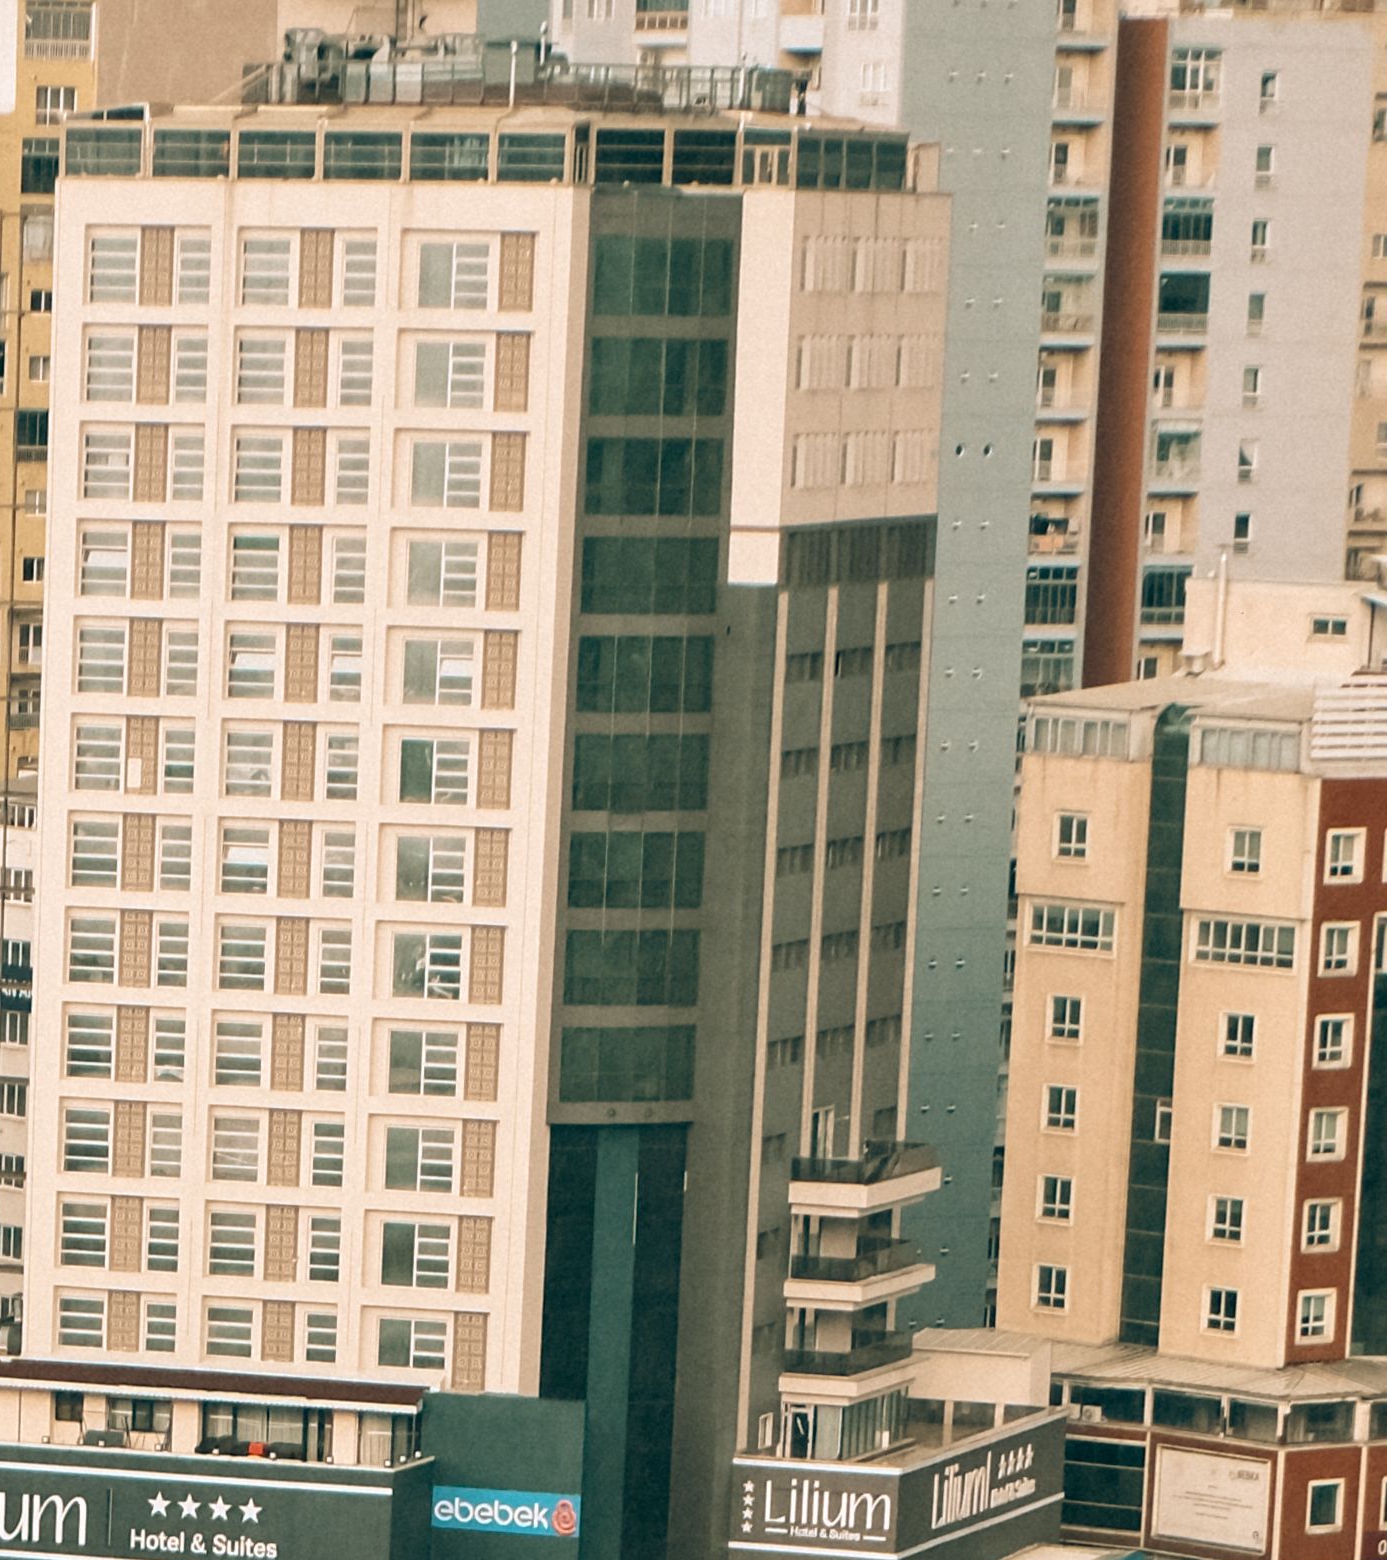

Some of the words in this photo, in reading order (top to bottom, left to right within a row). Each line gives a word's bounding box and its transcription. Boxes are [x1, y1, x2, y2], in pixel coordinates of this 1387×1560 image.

[432, 1496, 550, 1532] ebebek
[764, 1477, 892, 1531] Lilium
[129, 1527, 186, 1554] Hotel
[190, 1532, 207, 1555] &
[211, 1533, 278, 1560] Suites
